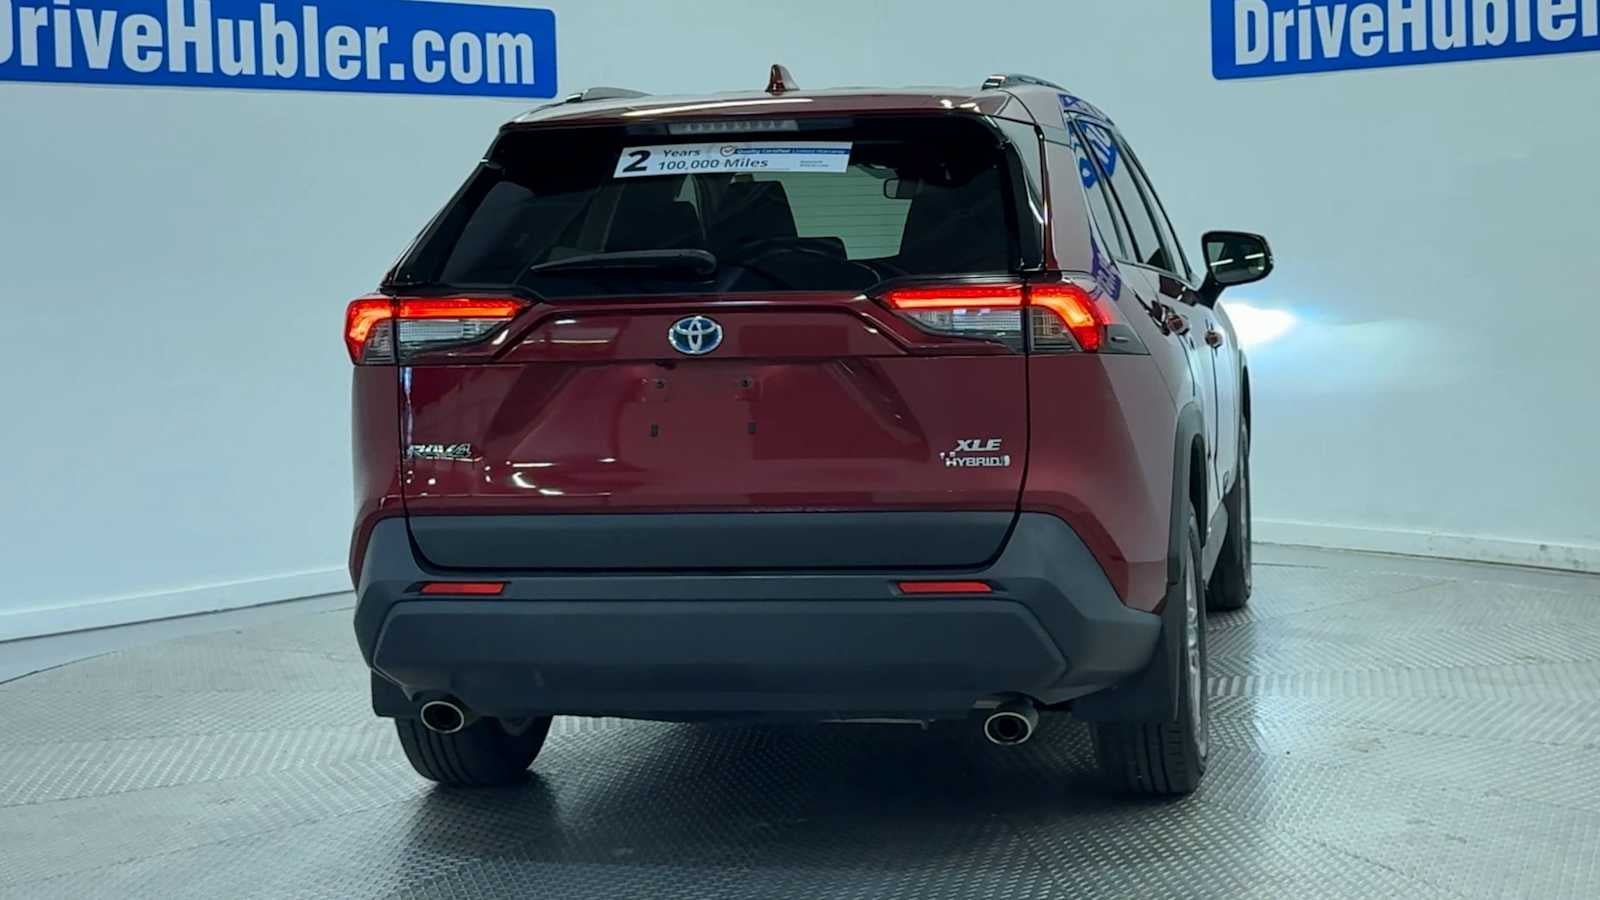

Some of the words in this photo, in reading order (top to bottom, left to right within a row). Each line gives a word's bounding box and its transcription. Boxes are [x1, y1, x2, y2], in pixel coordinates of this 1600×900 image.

[664, 149, 701, 158] Years
[622, 150, 651, 173] 2
[658, 160, 720, 171] 100,000
[724, 158, 769, 169] Miles
[954, 439, 1003, 452] XLE
[945, 457, 1003, 467] HYBRID
